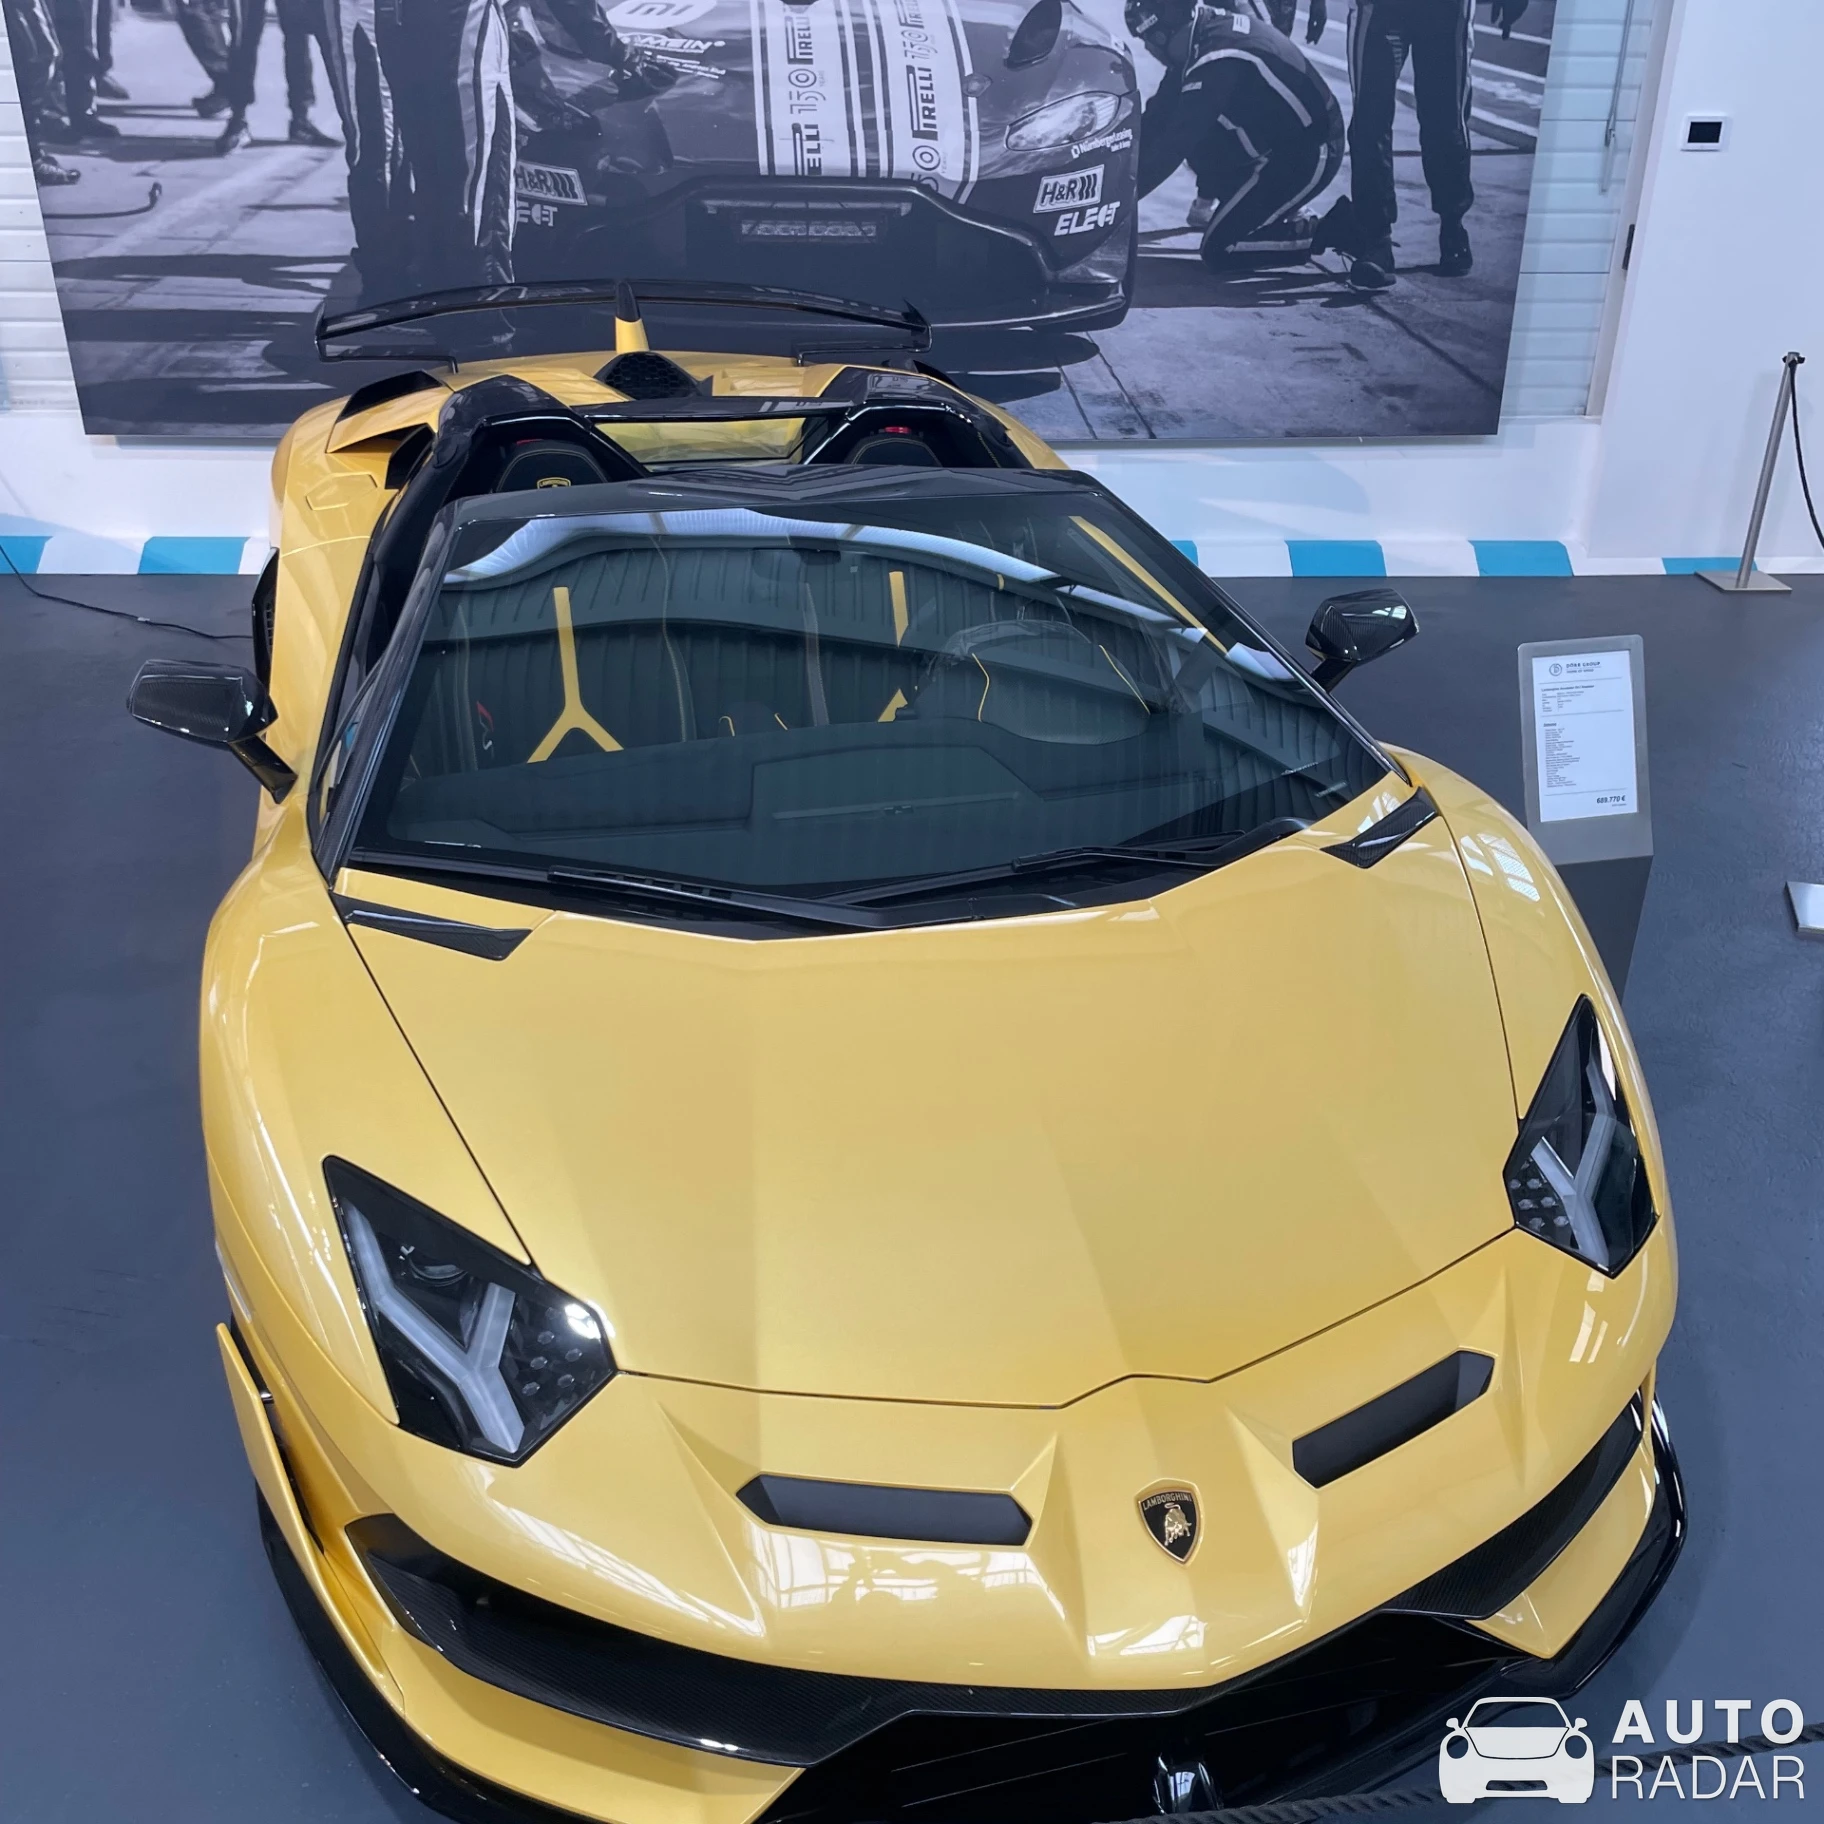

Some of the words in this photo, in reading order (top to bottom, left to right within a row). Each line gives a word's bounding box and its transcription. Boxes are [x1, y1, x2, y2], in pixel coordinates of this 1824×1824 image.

[788, 68, 826, 115] 150
[906, 65, 938, 141] PIRELLI
[911, 145, 941, 193] 50
[1142, 1492, 1192, 1511] LAMBORGHINI
